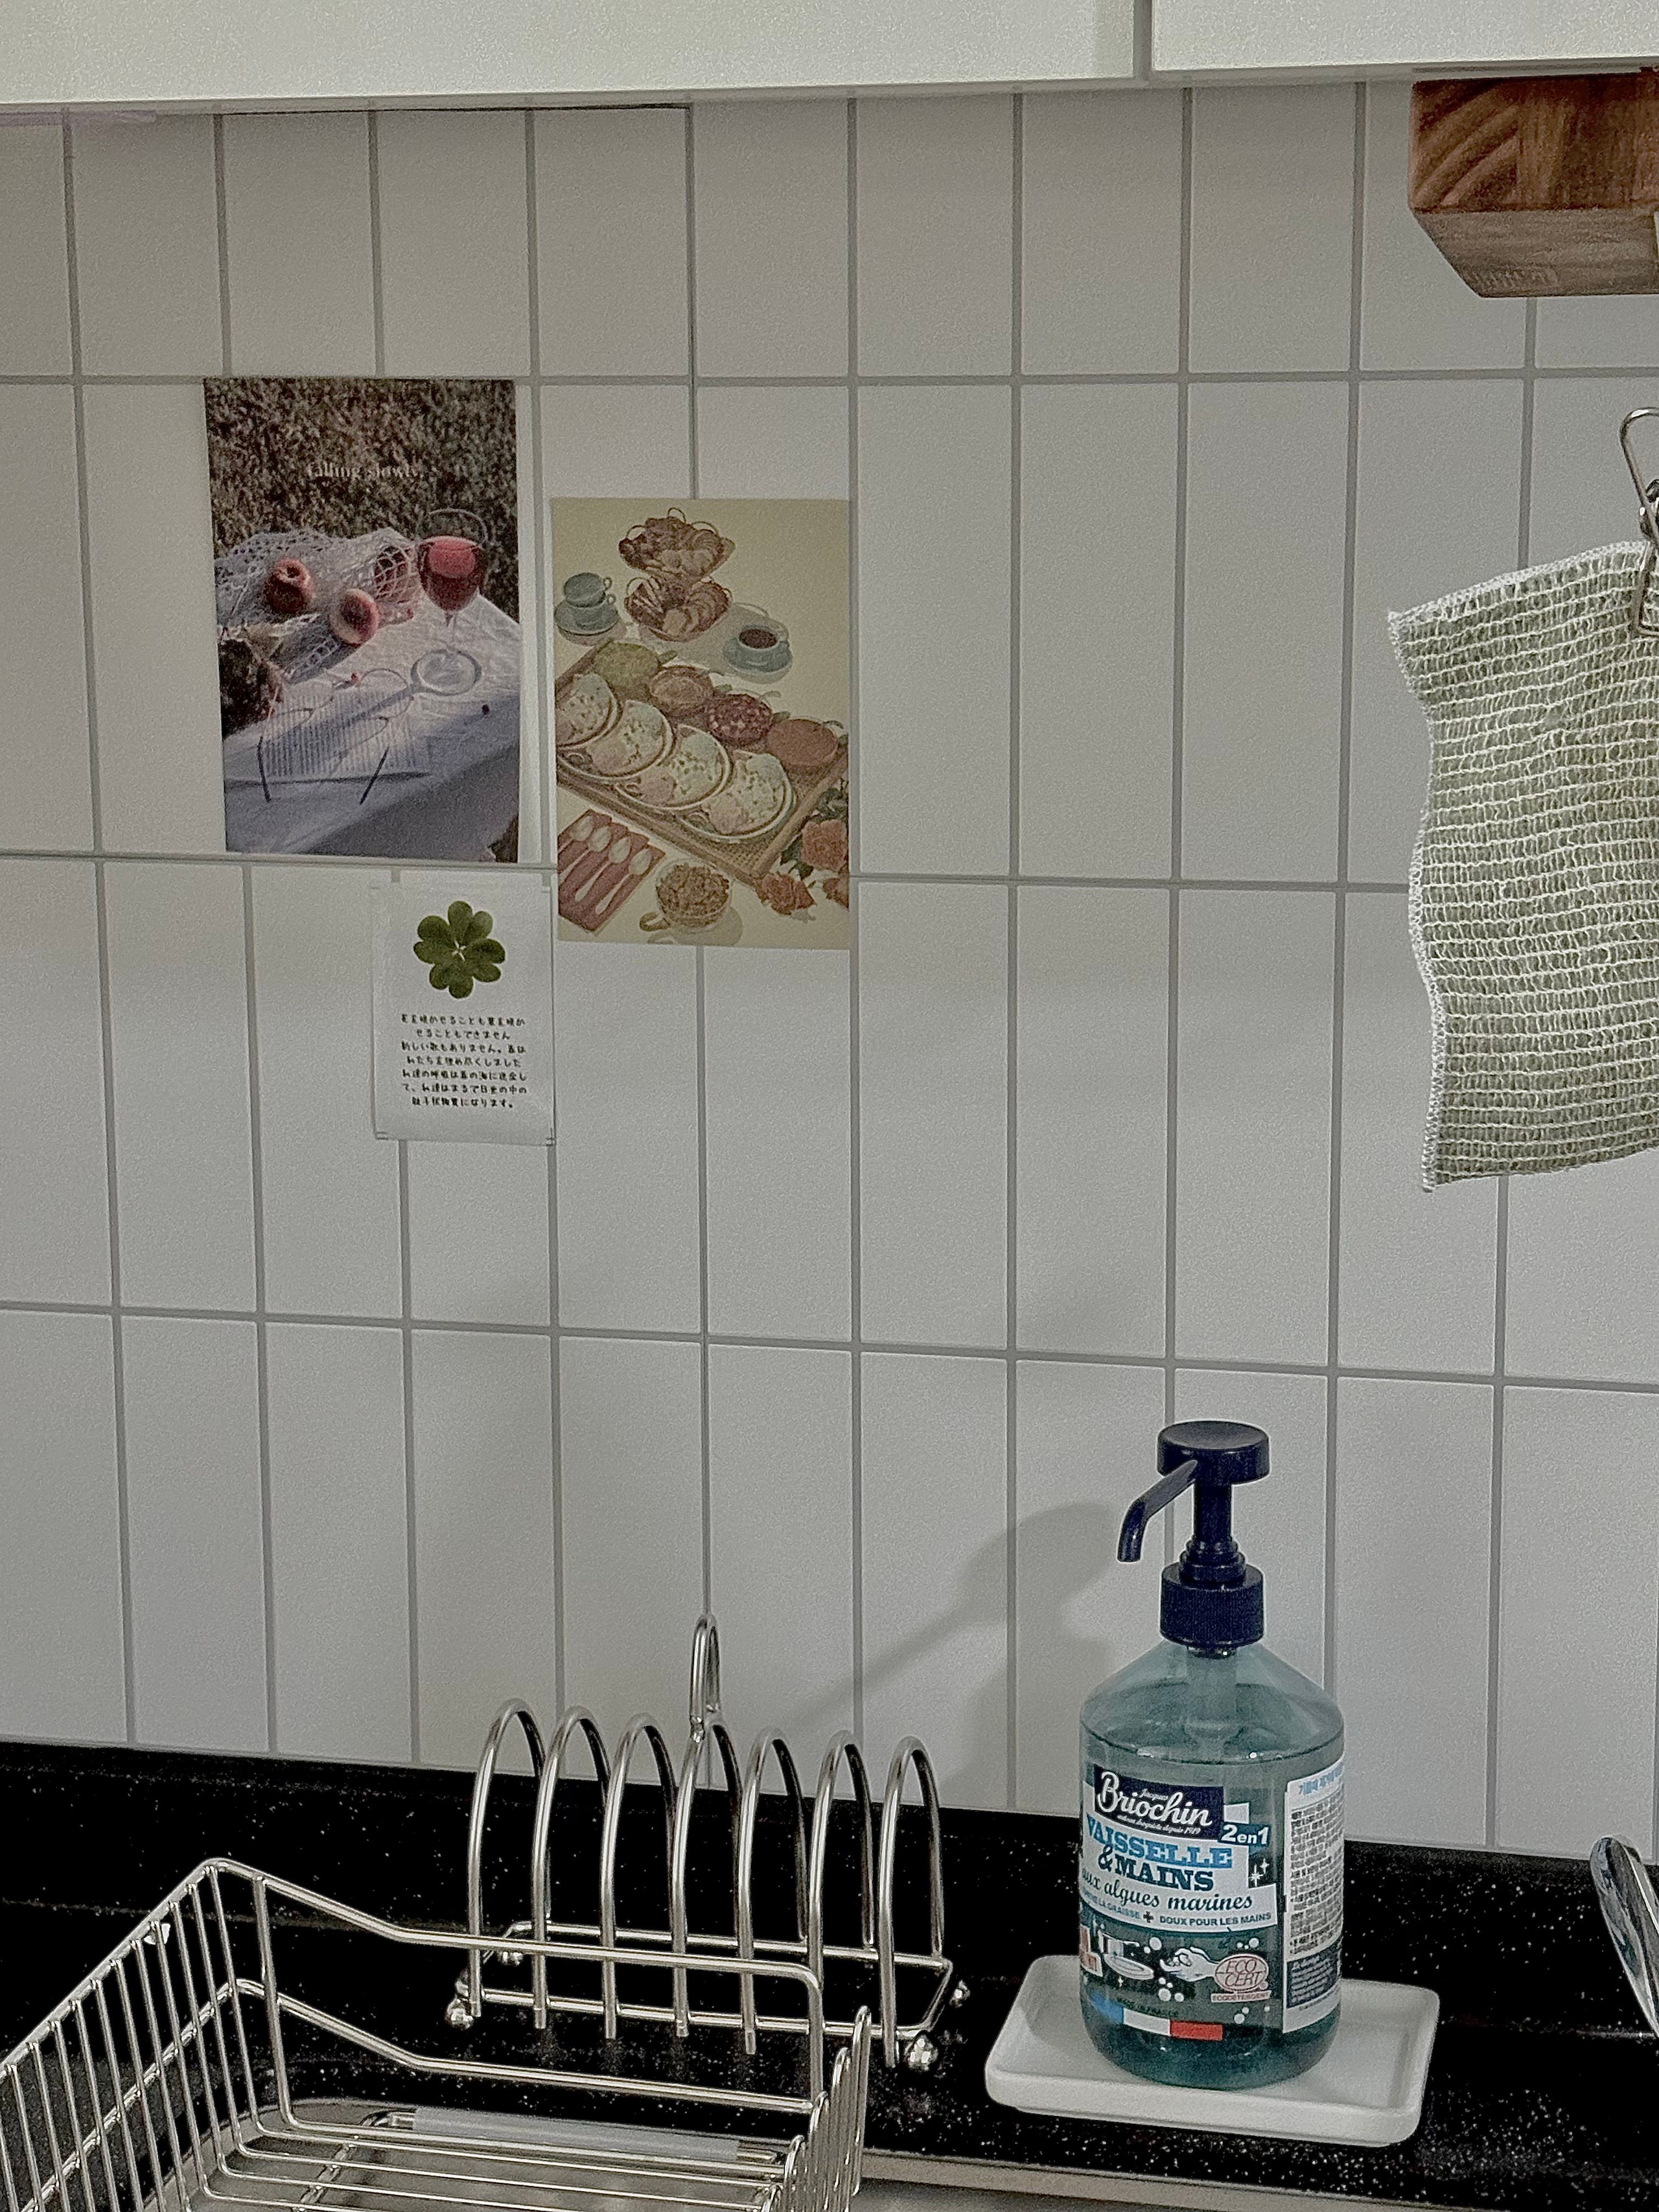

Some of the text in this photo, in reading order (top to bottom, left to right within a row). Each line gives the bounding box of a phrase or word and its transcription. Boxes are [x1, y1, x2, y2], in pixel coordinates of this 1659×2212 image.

[1097, 1771, 1212, 1826] Briochin
[1086, 1813, 1232, 1869] VAISSELLE
[1104, 1878, 1159, 1907] algues
[1168, 1894, 1252, 1911] marines
[1159, 1912, 1271, 1926] DOUX POUR LES MAINS
[1226, 1959, 1257, 1973] ECO
[1225, 1972, 1263, 1987] CERT
